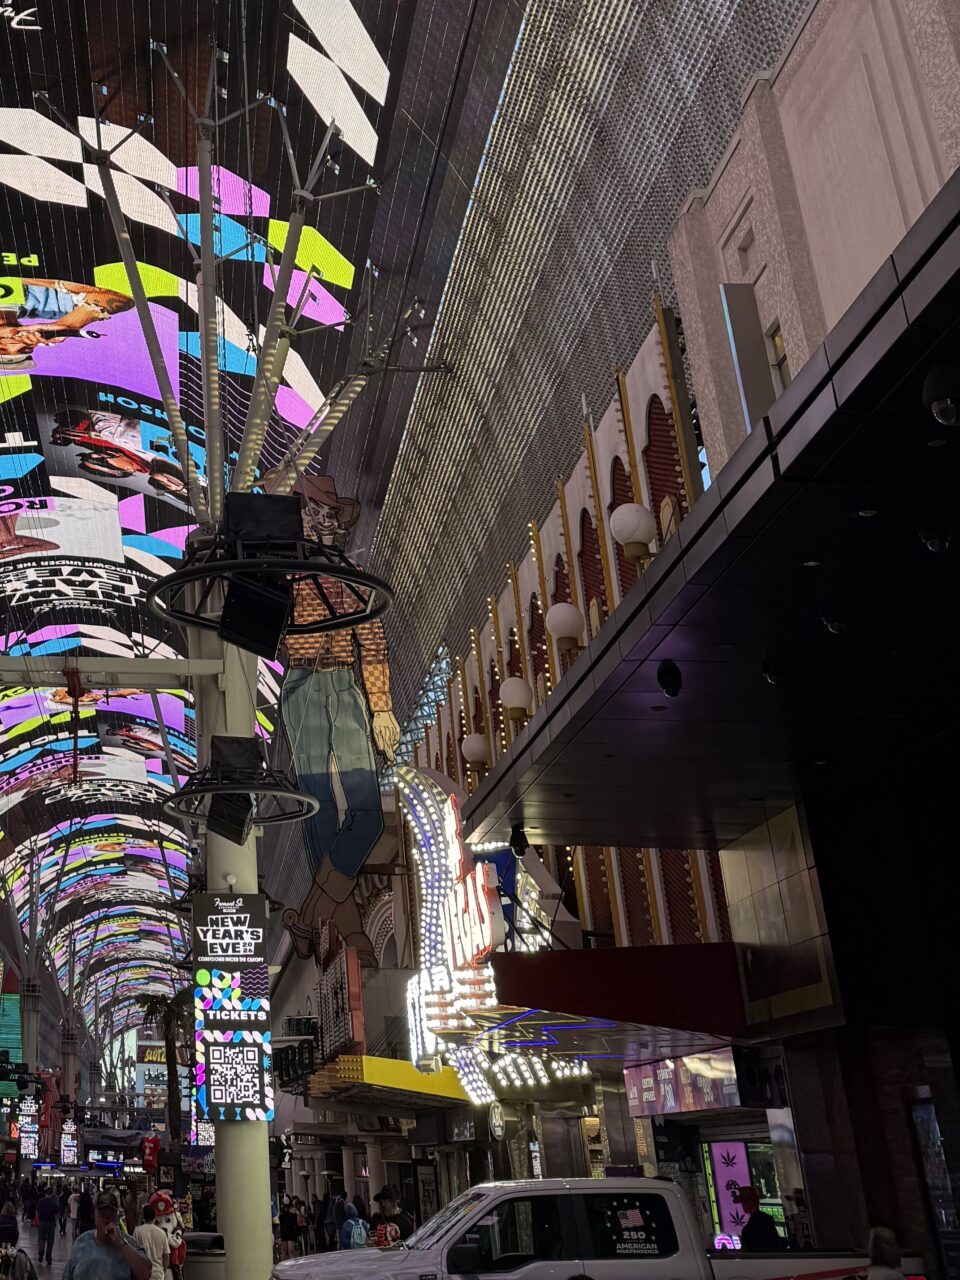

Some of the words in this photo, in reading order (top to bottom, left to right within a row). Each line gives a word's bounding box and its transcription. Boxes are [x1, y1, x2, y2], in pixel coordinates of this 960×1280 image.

[208, 915, 249, 928] NEW
[199, 928, 261, 941] YEAR'S
[209, 942, 241, 954] EVE
[206, 1010, 267, 1021] TICKETS
[623, 1231, 646, 1239] 250
